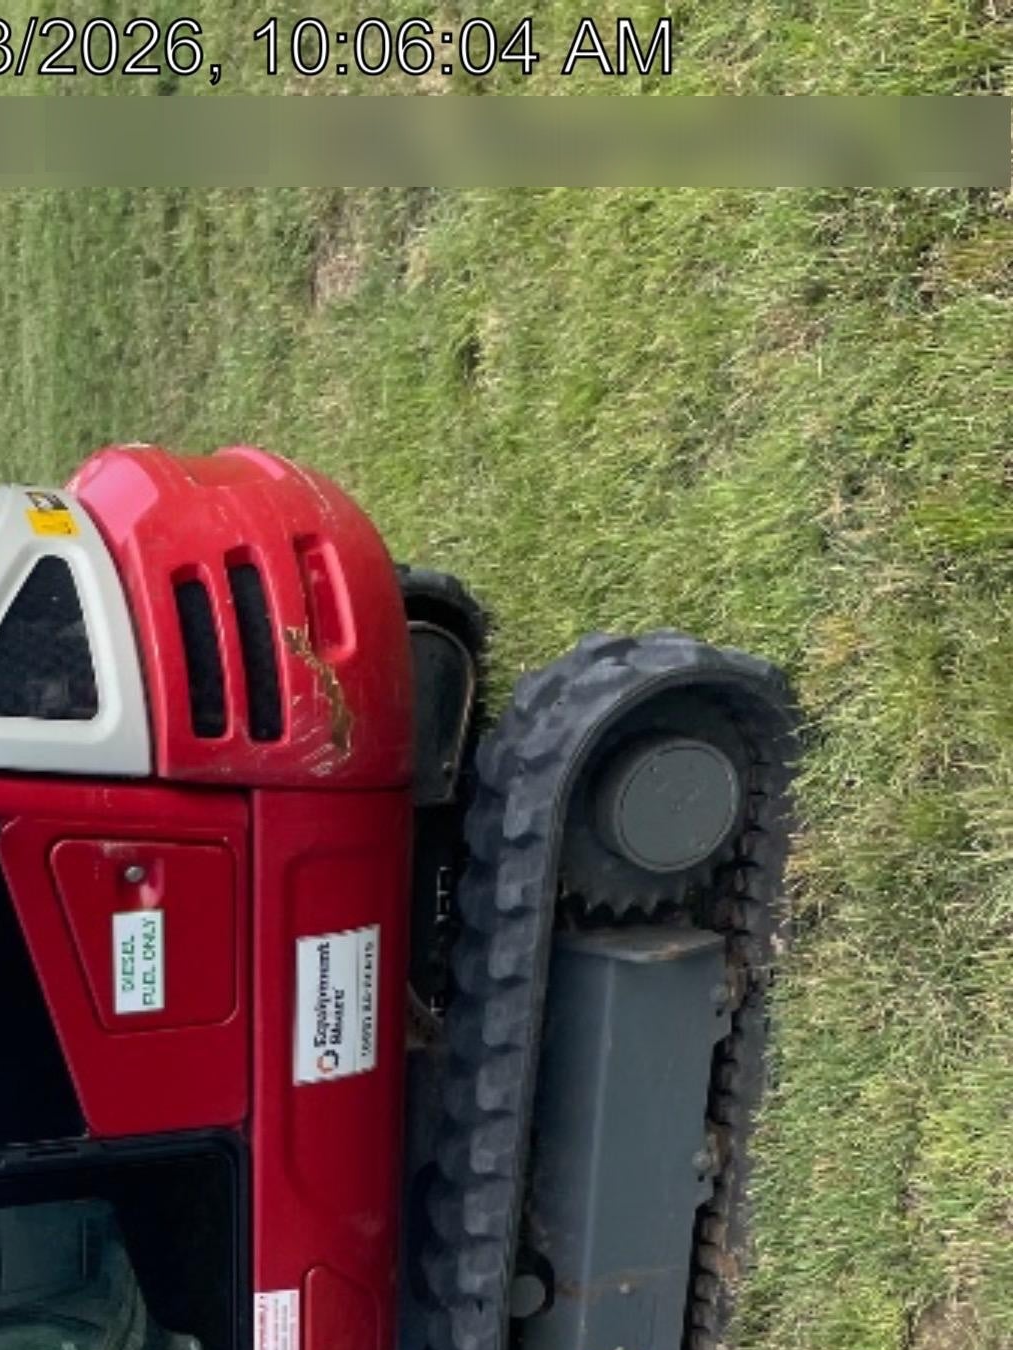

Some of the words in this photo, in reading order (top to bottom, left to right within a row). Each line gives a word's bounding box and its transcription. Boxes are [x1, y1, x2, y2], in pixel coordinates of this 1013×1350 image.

[121, 935, 135, 992] DIESEL
[141, 918, 156, 961] ONLY
[142, 966, 156, 1006] FUEL
[313, 942, 332, 1048] Equipment
[329, 989, 345, 1045] Share
